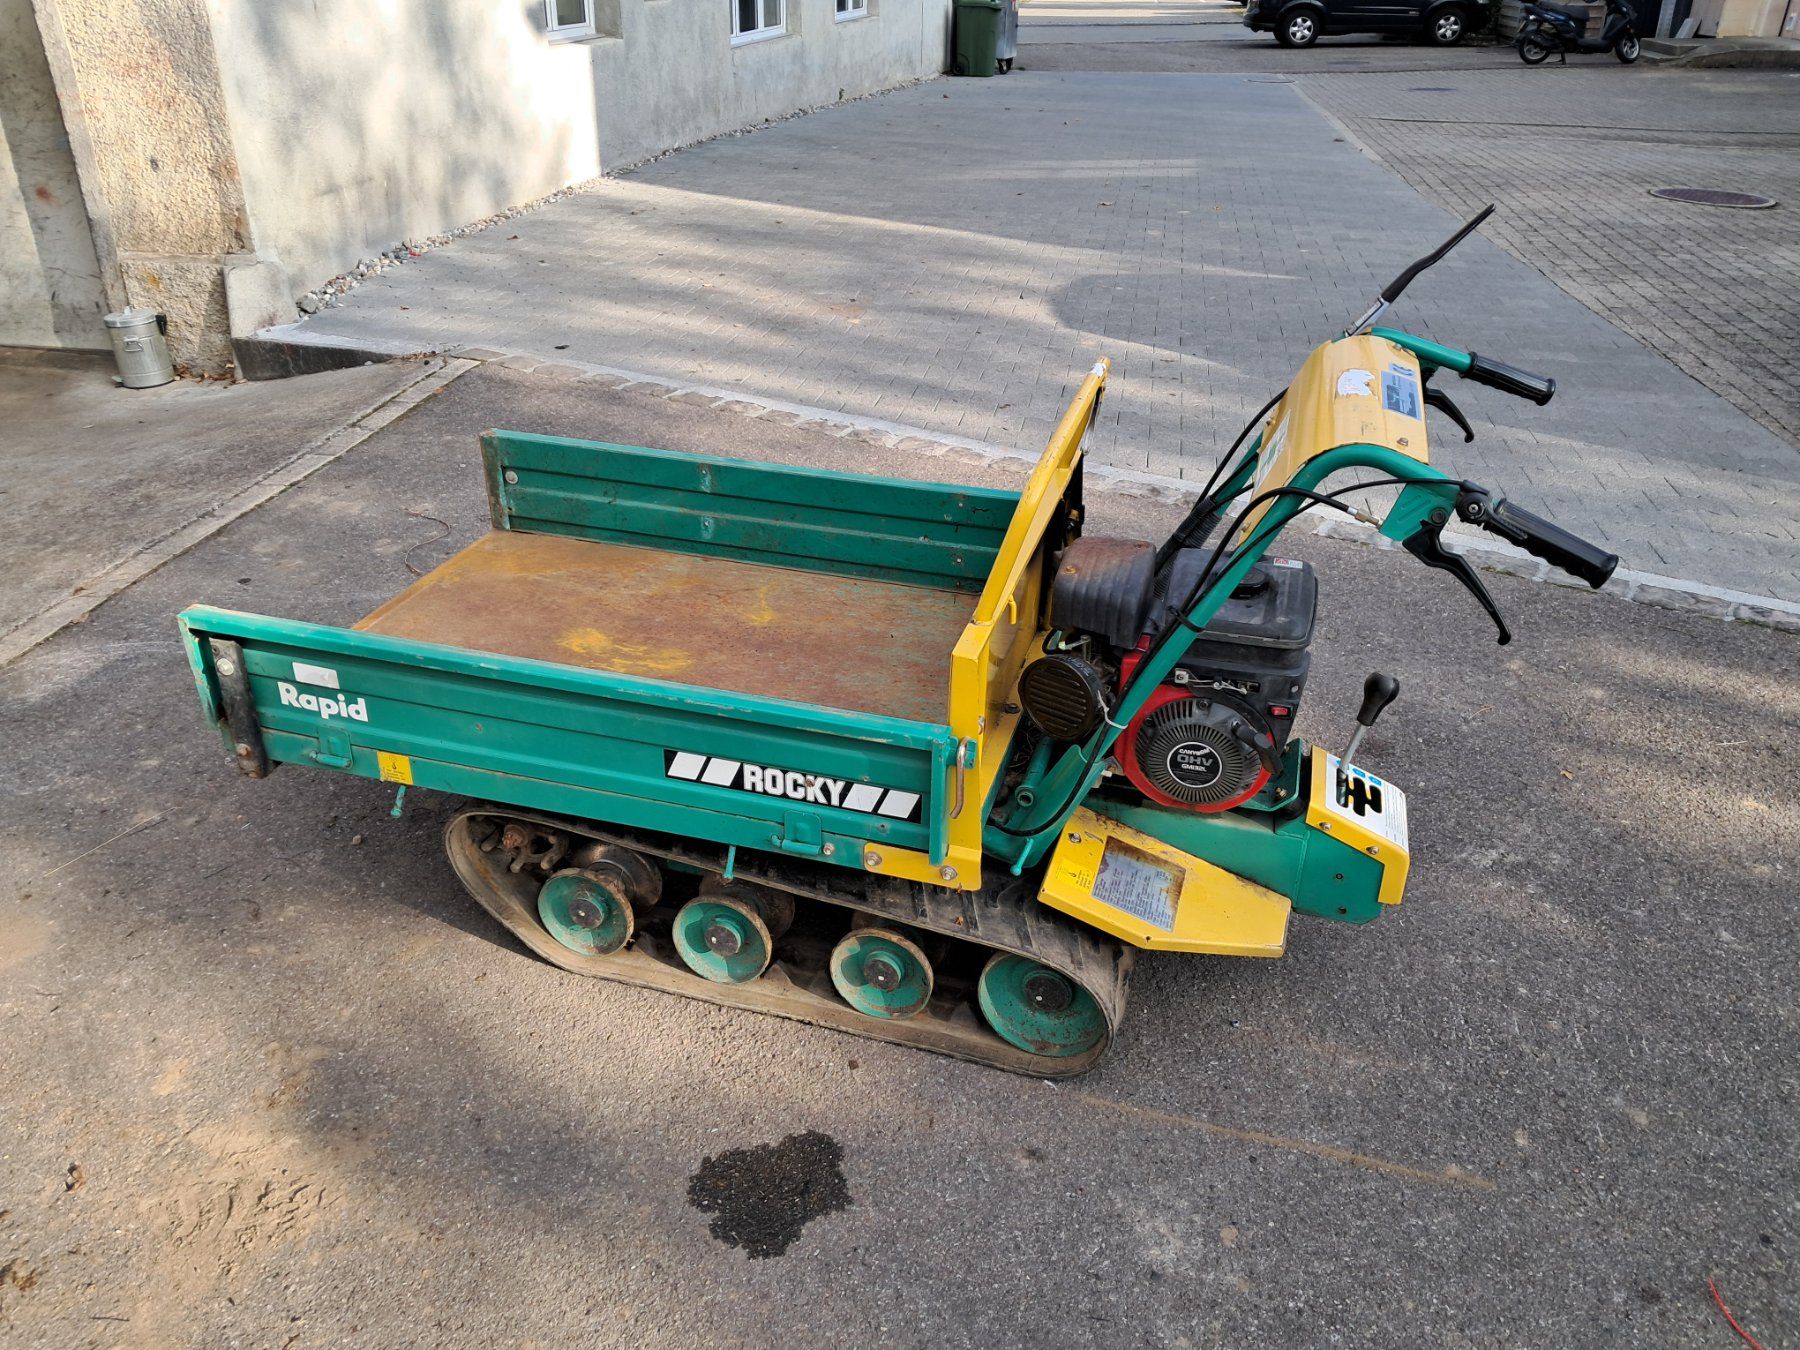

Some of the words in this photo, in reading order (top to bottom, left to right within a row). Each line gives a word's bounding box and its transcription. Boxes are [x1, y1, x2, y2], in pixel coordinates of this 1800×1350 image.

[277, 681, 369, 722] Rapid
[1177, 754, 1213, 767] OHV
[743, 763, 846, 806] ROCKY
